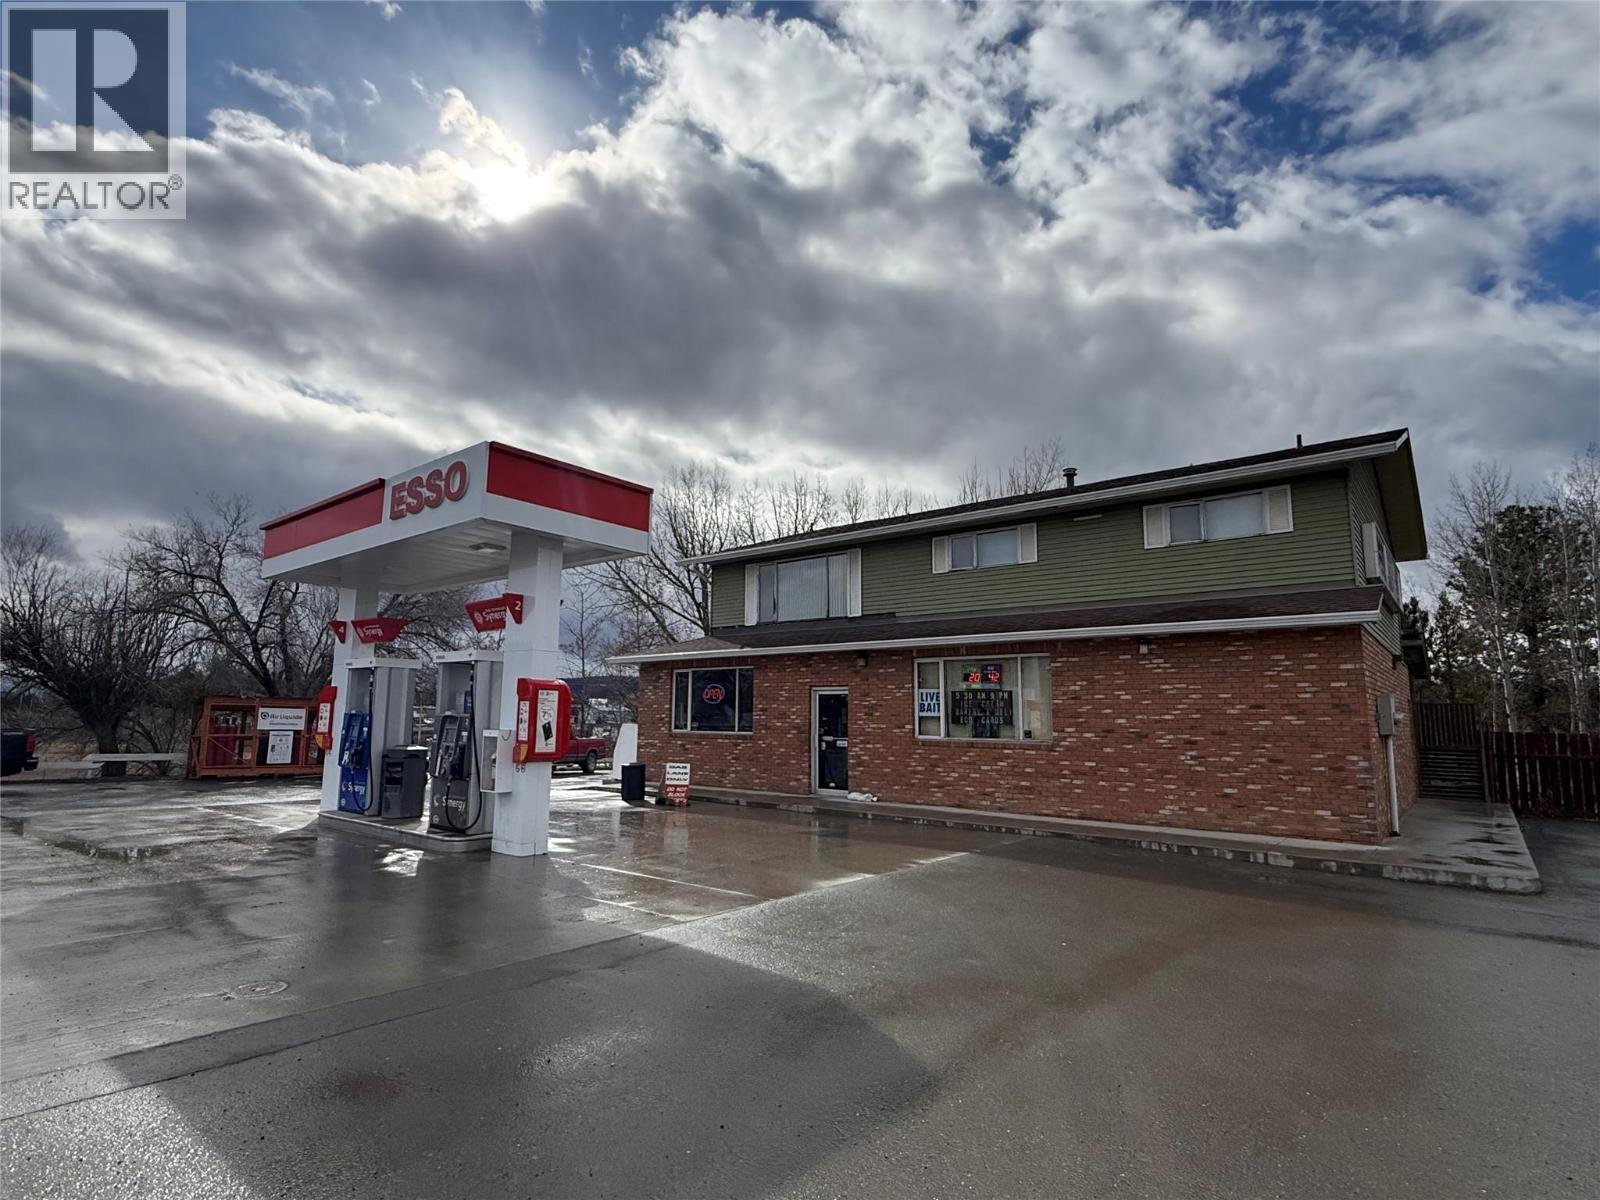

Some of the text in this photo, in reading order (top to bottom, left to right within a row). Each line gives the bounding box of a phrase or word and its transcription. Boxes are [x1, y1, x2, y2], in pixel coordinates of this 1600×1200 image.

[389, 461, 468, 520] ESSO
[514, 600, 522, 611] 2
[968, 672, 981, 682] 20
[987, 672, 1000, 682] 42
[920, 691, 941, 702] LIVE
[919, 702, 941, 713] BAIT
